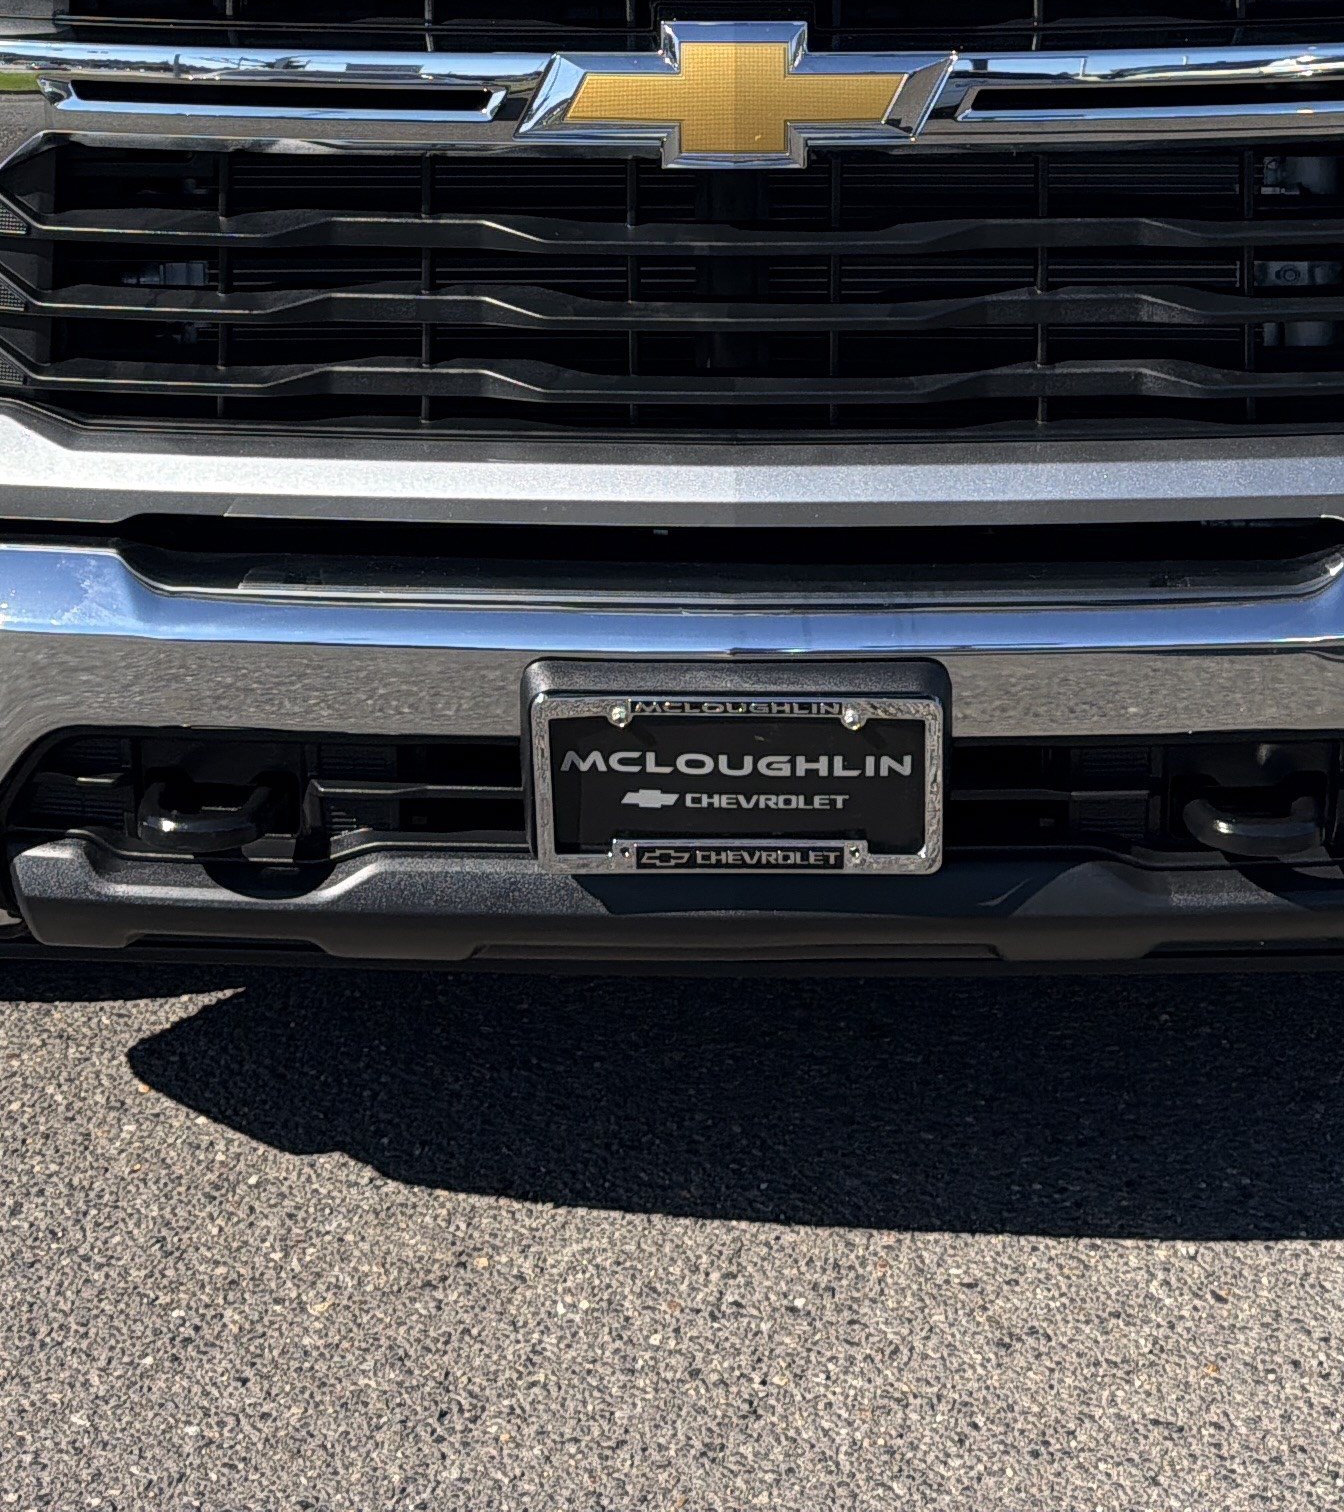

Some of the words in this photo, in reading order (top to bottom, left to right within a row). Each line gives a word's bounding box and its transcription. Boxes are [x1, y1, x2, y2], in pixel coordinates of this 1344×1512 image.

[636, 702, 842, 715] MCLOUGHLIN
[560, 750, 913, 778] MCLOUGHLIN
[685, 793, 850, 809] CHEVROLET
[696, 850, 841, 867] CHEVROLET
